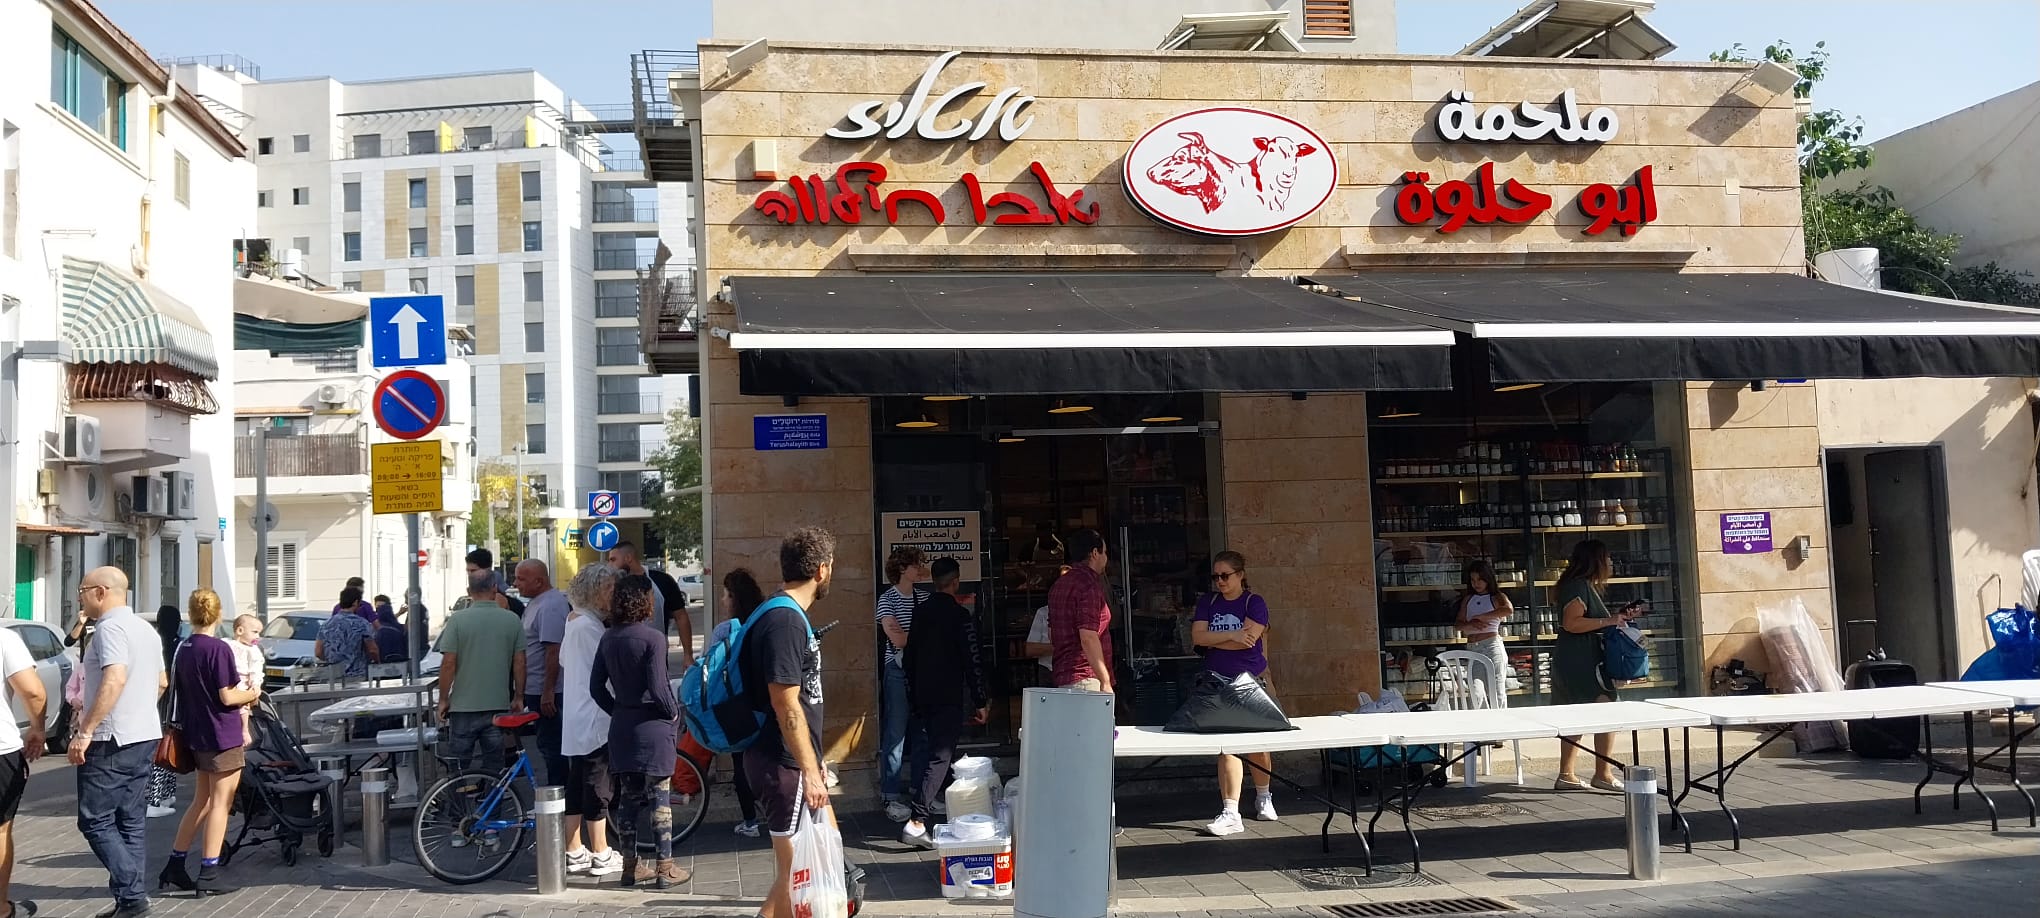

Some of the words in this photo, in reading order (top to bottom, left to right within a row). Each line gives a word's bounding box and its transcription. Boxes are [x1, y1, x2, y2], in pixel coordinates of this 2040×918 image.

[826, 51, 1036, 141] אטליז
[1437, 88, 1619, 142] ملحمة
[755, 162, 945, 225] חילווה
[962, 161, 1100, 225] אבו
[1395, 162, 1552, 232] حلوة
[1578, 165, 1658, 236] ابو
[408, 454, 434, 462] פריקה
[900, 520, 922, 528] קשים
[932, 542, 944, 550] על
[984, 868, 990, 877] 4
